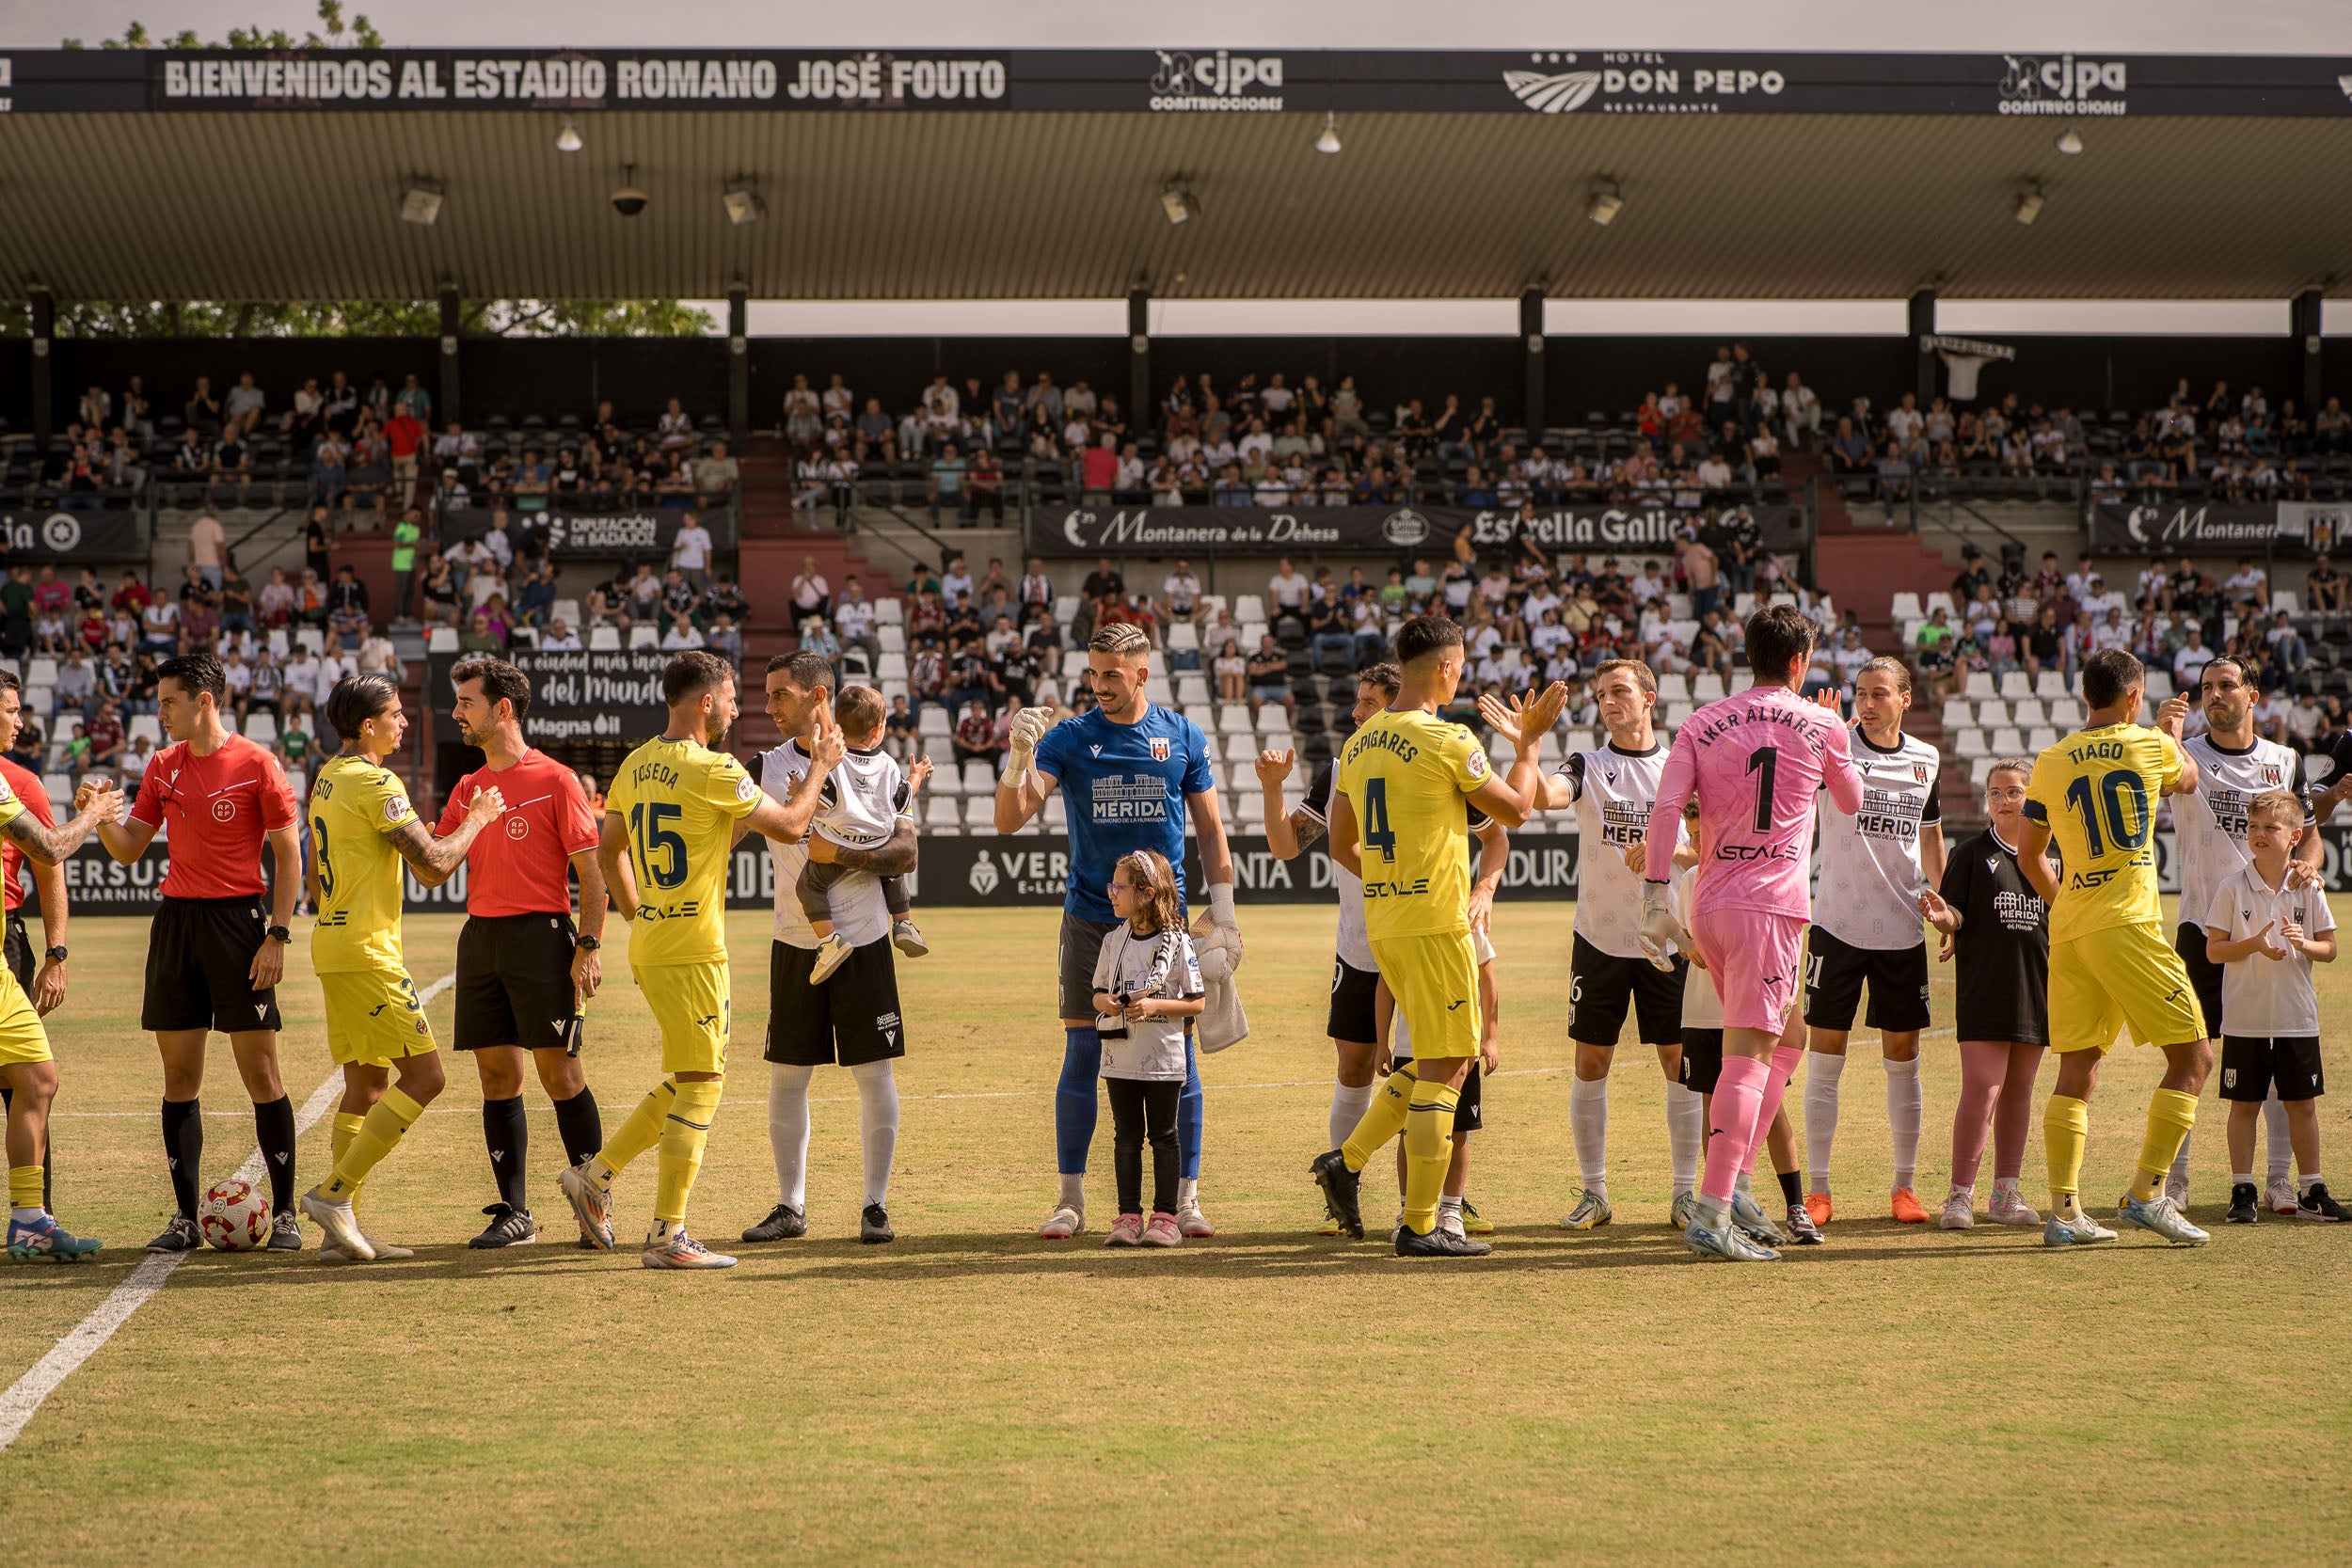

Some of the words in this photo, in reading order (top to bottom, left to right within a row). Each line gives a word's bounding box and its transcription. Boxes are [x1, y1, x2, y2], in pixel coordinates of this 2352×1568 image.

[1603, 53, 1665, 64] HOTEL
[165, 59, 391, 97] BIENVENIDOS
[397, 60, 446, 97] AL
[453, 59, 606, 98] ESTADIO
[616, 60, 777, 99] ROMANO
[787, 52, 882, 99] JOSÉ
[891, 60, 1006, 100] FOUTO
[1603, 70, 1679, 93] DON
[1694, 70, 1785, 94] PEPO
[1603, 103, 1720, 113] RESTAURANTE
[570, 513, 657, 533] DIPUTACIÓN
[1099, 509, 1227, 546] Montanera
[1266, 514, 1340, 543] Dehesa
[570, 534, 587, 546] DE
[588, 531, 657, 546] BADAJOZ
[541, 673, 580, 706] del
[1697, 713, 1740, 747] IKER
[1745, 705, 1826, 753] ÁLVAREZ
[1347, 729, 1419, 766] ESPIGARES
[2067, 742, 2123, 766] TIAGO
[1745, 746, 1777, 835] 1
[1092, 800, 1167, 817] MÉRIDA
[1364, 777, 1397, 863] 4
[2064, 769, 2149, 860] 10
[1856, 814, 1917, 838] MÉRIDA
[629, 802, 688, 890] 15
[1001, 851, 1069, 879] VER
[1999, 909, 2040, 922] MÉRIDA
[400, 977, 421, 1012] 3
